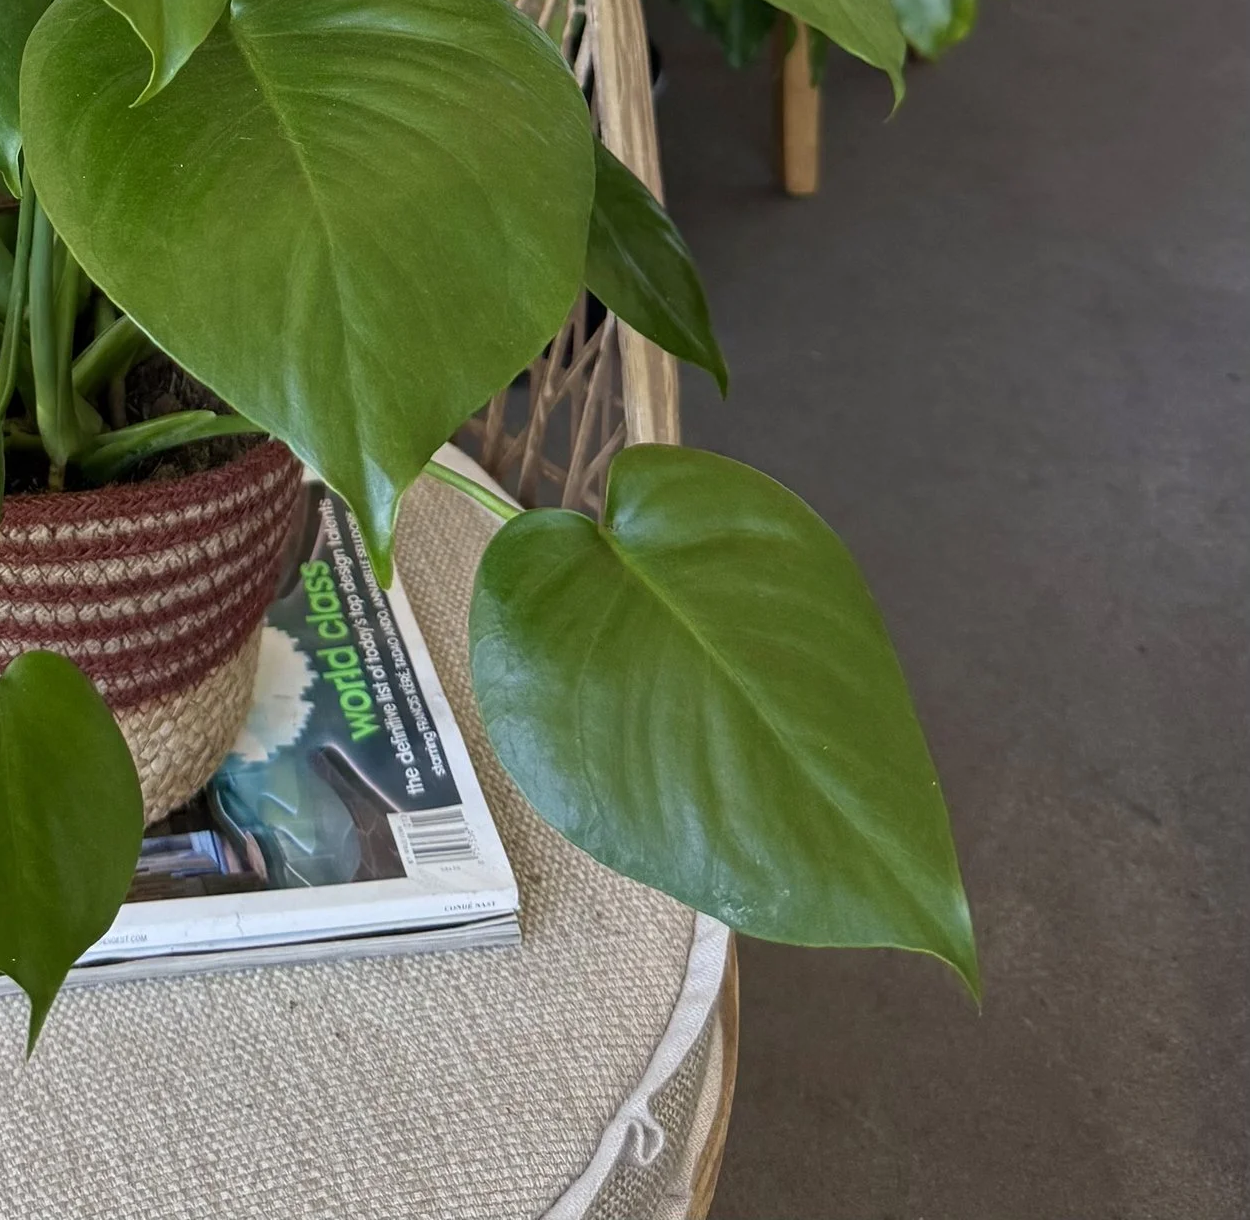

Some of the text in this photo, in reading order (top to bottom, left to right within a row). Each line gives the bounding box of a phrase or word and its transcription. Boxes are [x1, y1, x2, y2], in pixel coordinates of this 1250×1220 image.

[317, 498, 342, 547] talents
[333, 549, 356, 591] design
[359, 559, 386, 607] ANNABELLE
[347, 595, 366, 616] top
[377, 608, 397, 637] ANDO,
[299, 560, 379, 740] world class
[354, 618, 381, 664] today's
[388, 637, 408, 668] TADAO
[367, 665, 386, 680] of
[372, 683, 394, 701] list
[406, 695, 431, 731] FRANCIS
[381, 703, 414, 763] definitive
[423, 731, 446, 776] starring
[404, 767, 425, 795] the
